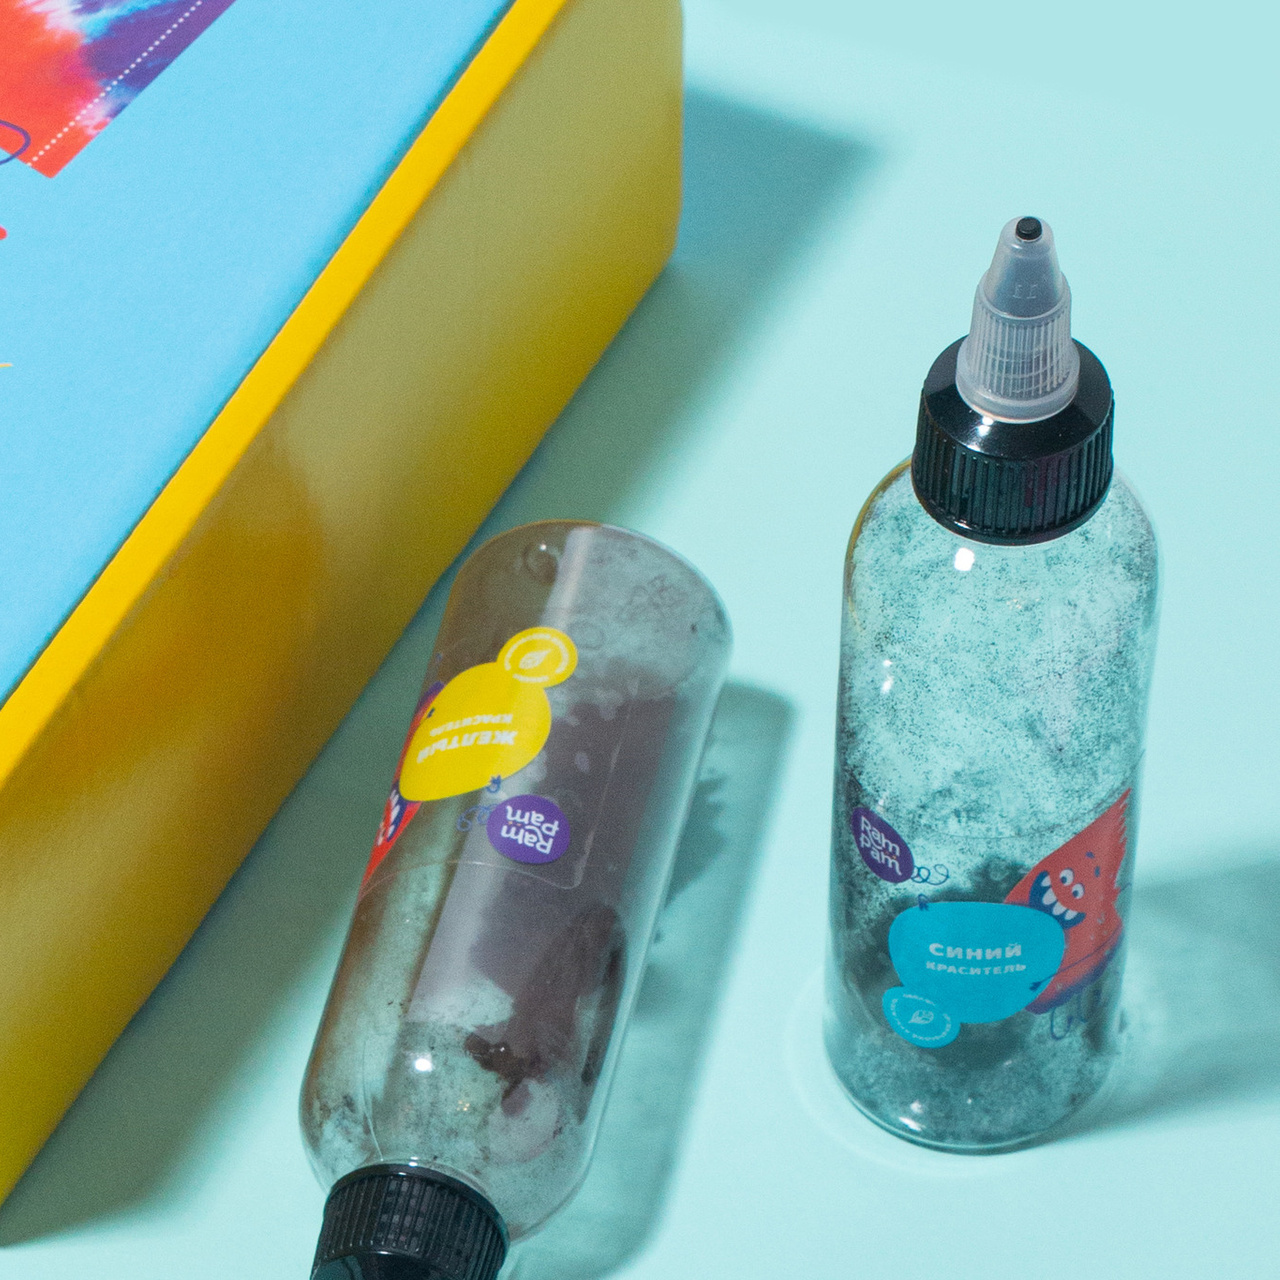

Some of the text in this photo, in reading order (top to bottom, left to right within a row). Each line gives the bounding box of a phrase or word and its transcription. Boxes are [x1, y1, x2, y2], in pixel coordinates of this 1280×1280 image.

[501, 821, 554, 855] Ram
[861, 815, 900, 857] Ram
[928, 942, 1022, 961] СИНИЙ
[925, 961, 1027, 976] КРАСИТЕЛЬ
